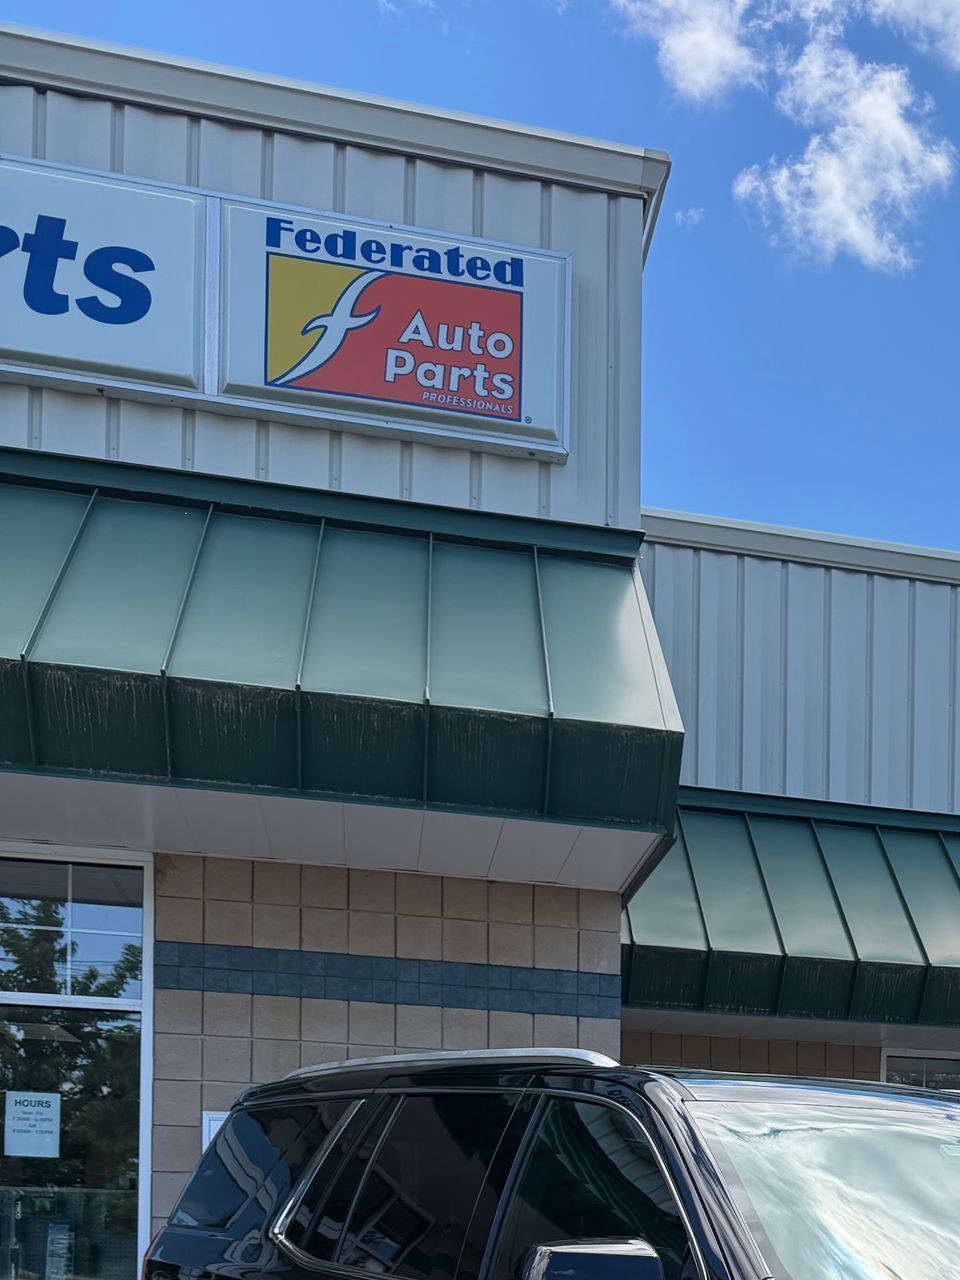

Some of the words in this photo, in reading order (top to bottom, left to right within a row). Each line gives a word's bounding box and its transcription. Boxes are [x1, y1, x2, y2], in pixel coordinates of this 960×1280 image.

[0, 214, 156, 325] ts
[266, 216, 524, 288] Federated
[398, 309, 514, 359] Auto
[384, 348, 515, 400] Parts
[422, 391, 513, 414] PROFESSIONALS
[14, 1098, 52, 1109] HOURS
